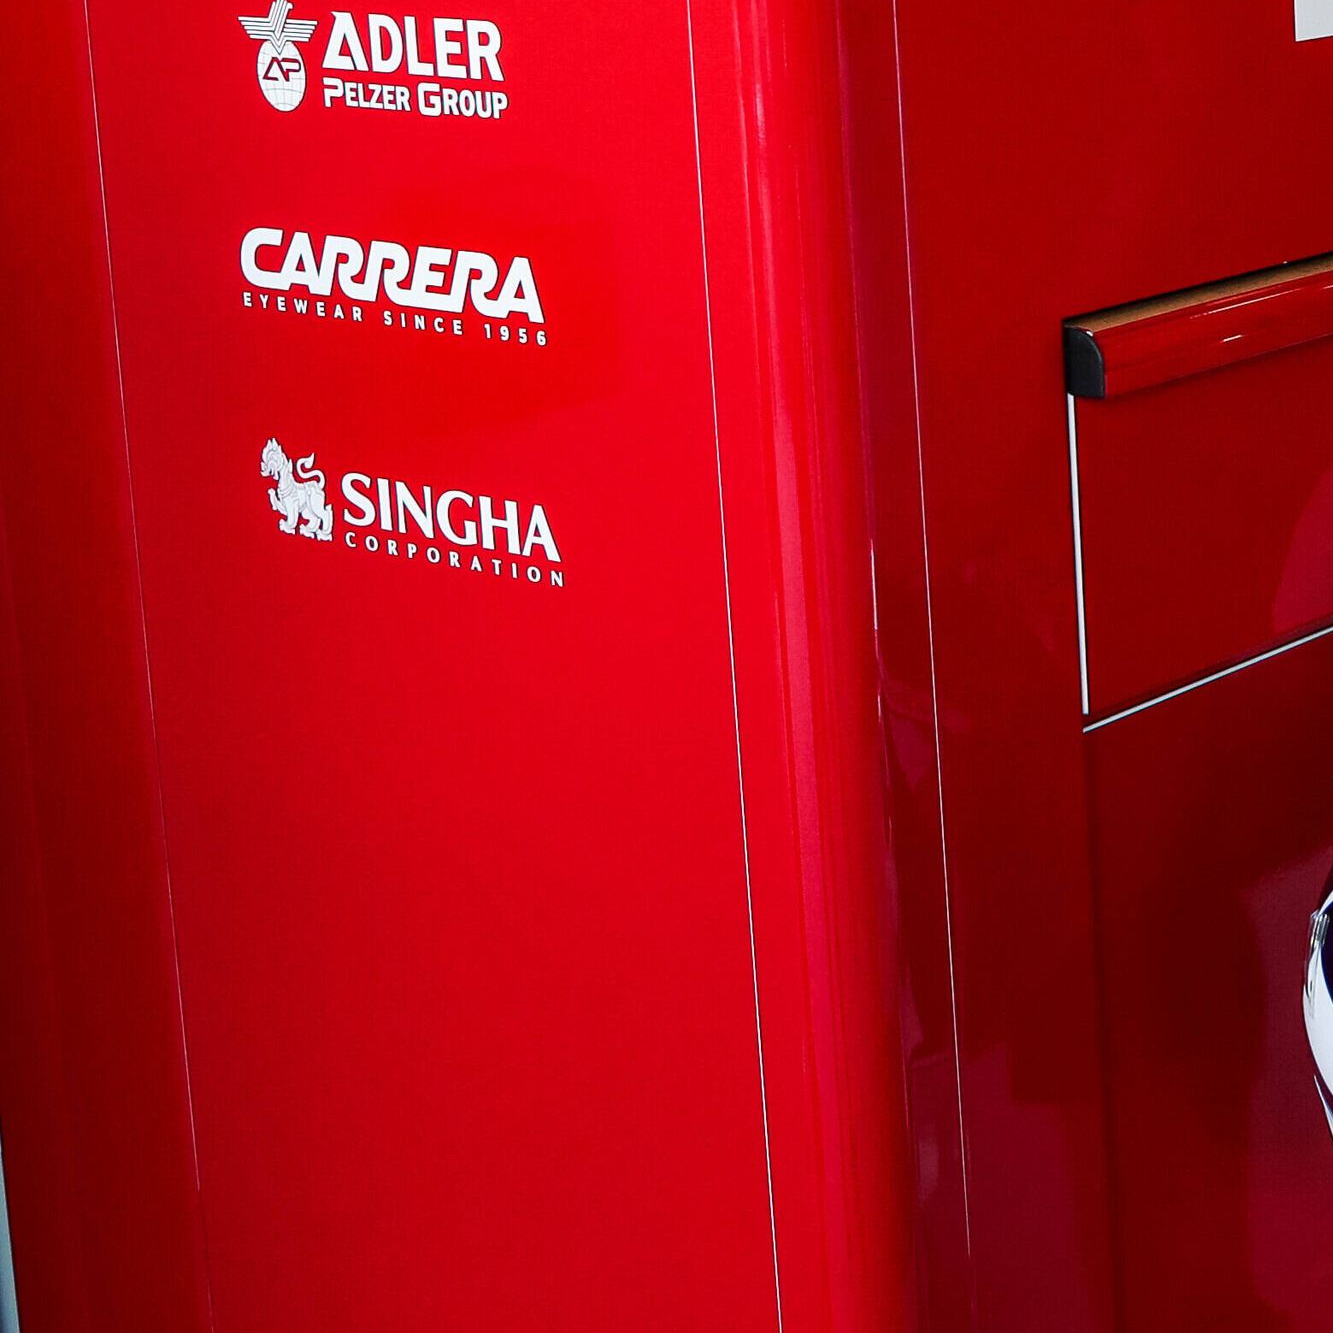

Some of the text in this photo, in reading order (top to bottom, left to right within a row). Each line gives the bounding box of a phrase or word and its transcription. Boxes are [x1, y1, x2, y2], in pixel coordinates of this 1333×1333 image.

[321, 10, 505, 82] ADLER
[324, 76, 510, 120] PELZER GROUP
[239, 226, 546, 324] CARRERA
[243, 292, 547, 347] EYEWEAR SINCE 1956
[340, 472, 562, 563] SINGHA
[345, 532, 565, 588] CORPORATION
